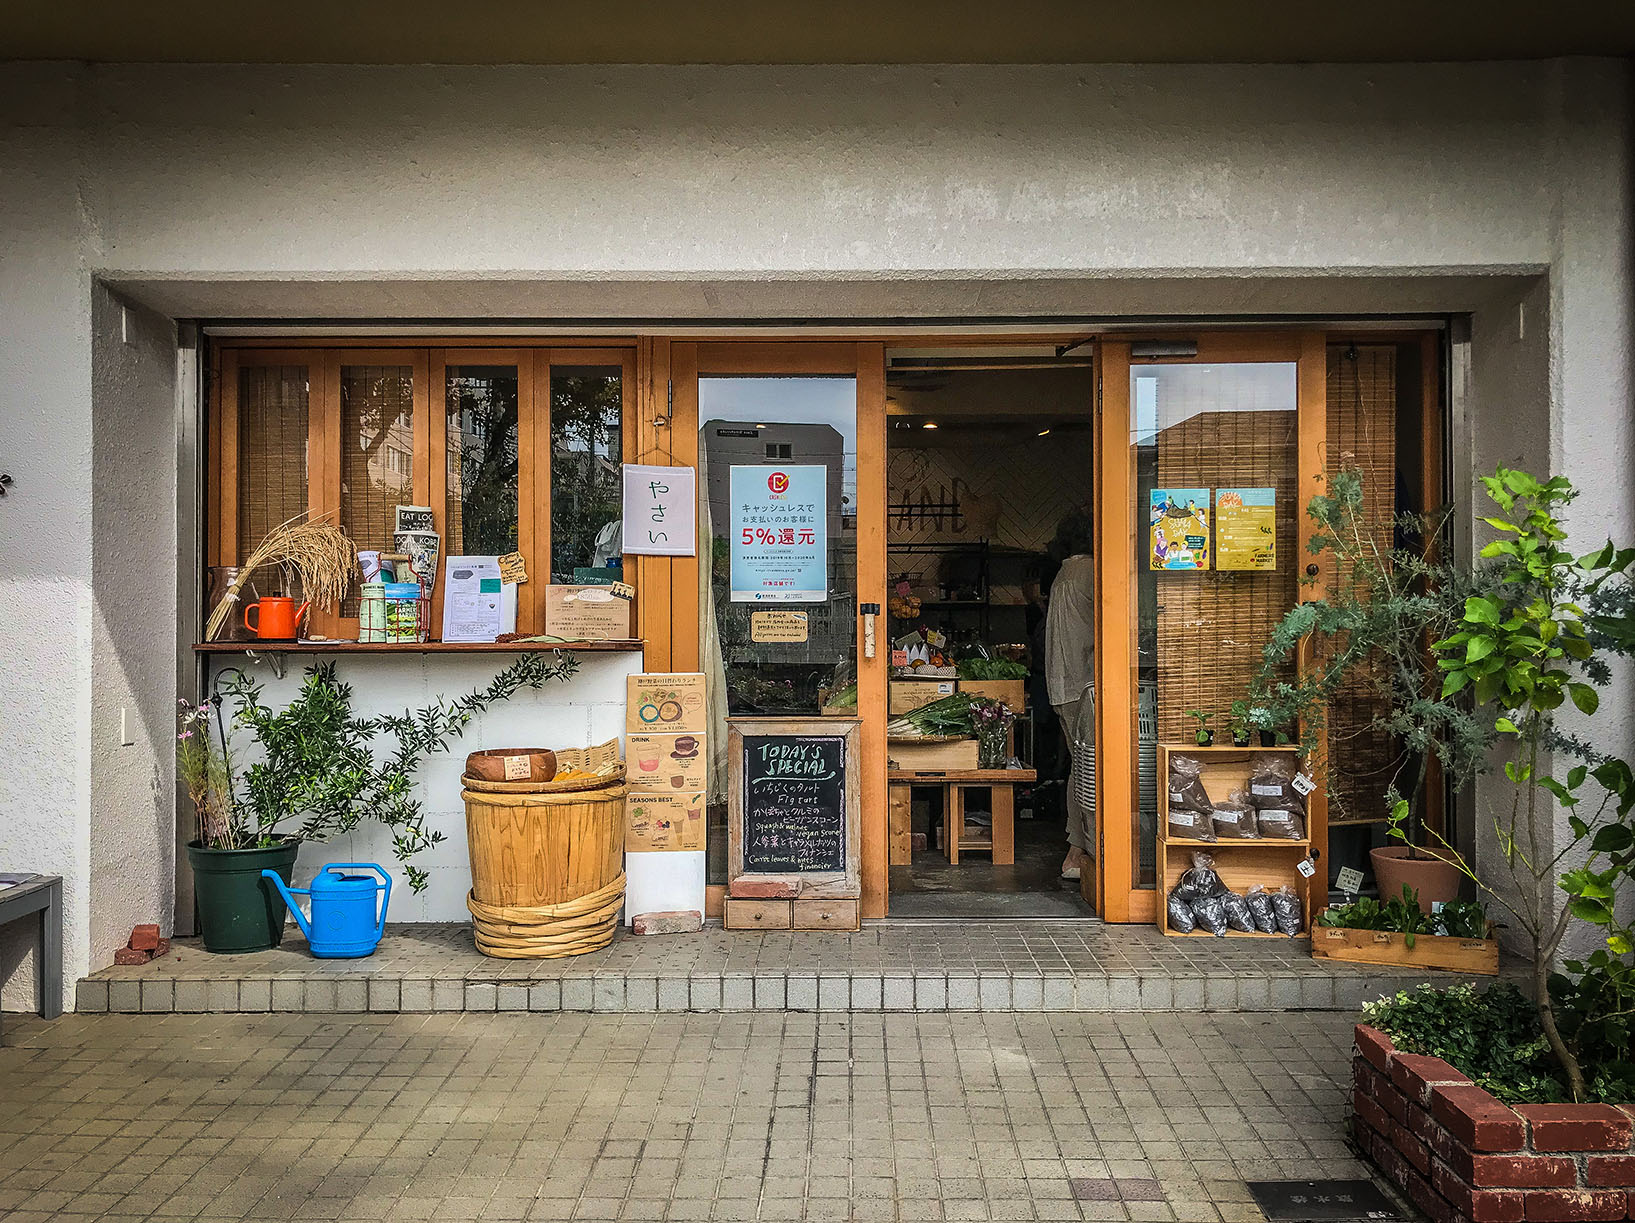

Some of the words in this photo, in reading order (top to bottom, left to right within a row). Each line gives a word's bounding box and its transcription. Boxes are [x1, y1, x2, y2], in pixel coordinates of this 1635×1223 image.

[401, 512, 415, 520] EAT
[648, 480, 670, 544] やさい
[742, 503, 815, 513] キャッシュレスで
[742, 515, 815, 524] お支払いのお客様に
[742, 528, 815, 545] 5%還元
[757, 742, 823, 761] TODAY'S
[765, 759, 827, 776] SPECIAL
